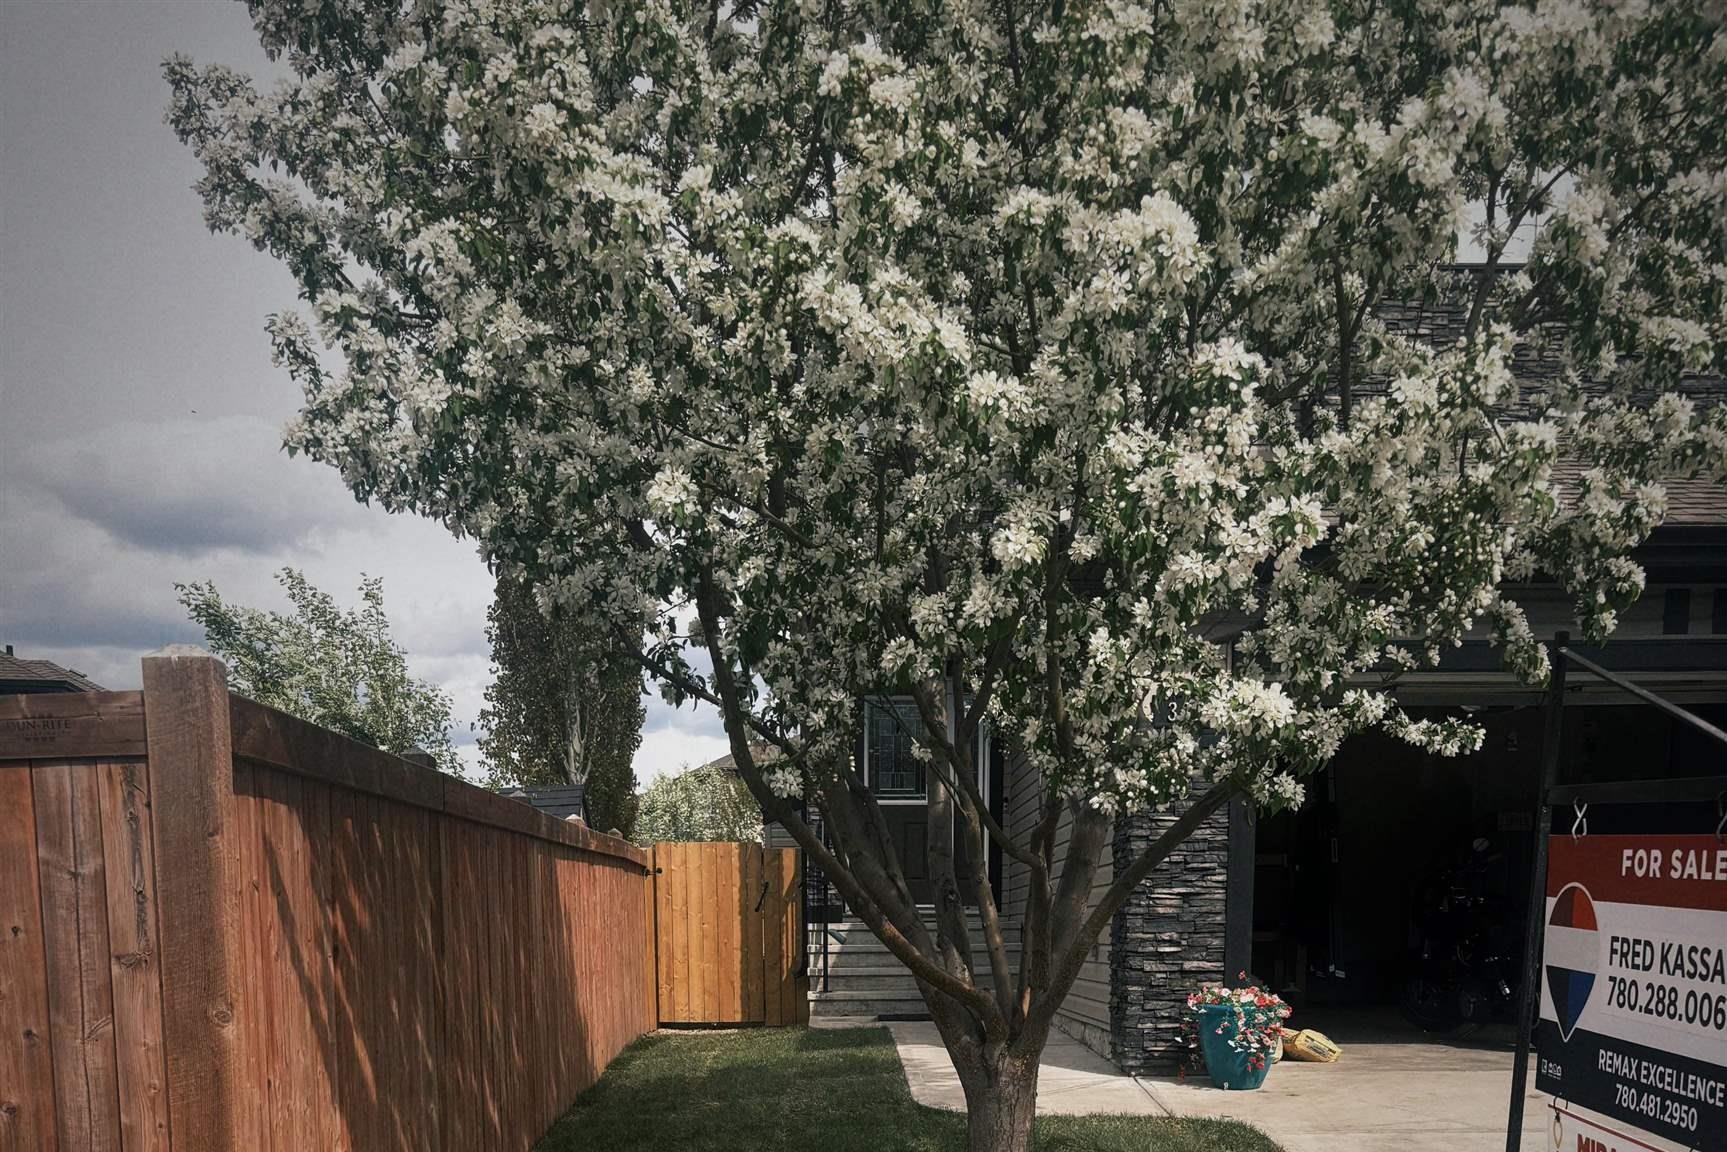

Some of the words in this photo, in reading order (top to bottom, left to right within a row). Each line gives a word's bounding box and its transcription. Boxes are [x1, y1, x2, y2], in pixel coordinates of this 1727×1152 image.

[1621, 848, 1662, 878] FOR
[1669, 849, 1727, 880] SALE
[1609, 935, 1655, 972] FRED
[1607, 975, 1727, 1031] 780.288.006
[1598, 1049, 1639, 1081] REMAX
[1640, 1060, 1726, 1107] EXCELLENCE
[1615, 1083, 1698, 1132] 780.481.2950
